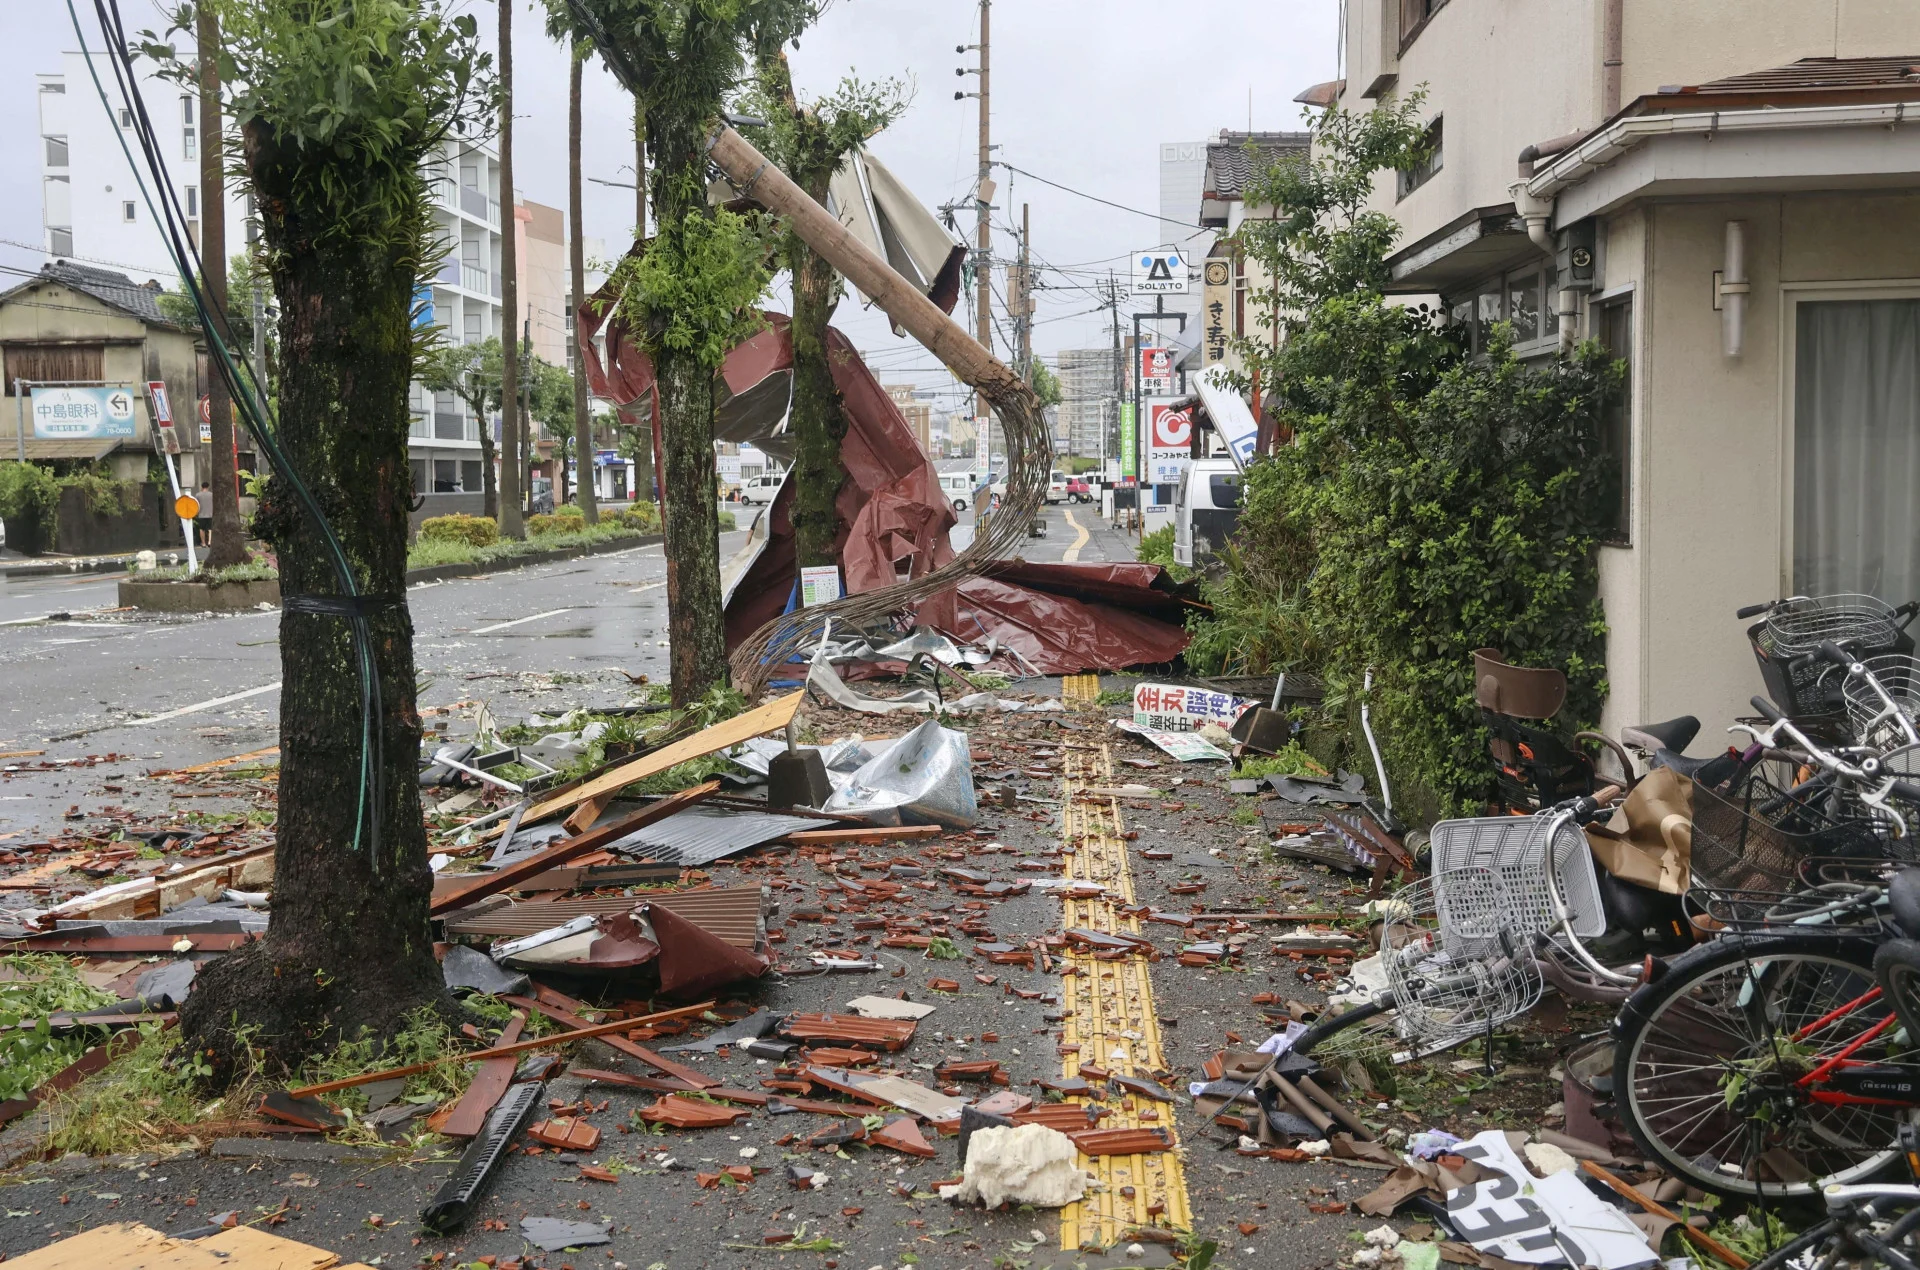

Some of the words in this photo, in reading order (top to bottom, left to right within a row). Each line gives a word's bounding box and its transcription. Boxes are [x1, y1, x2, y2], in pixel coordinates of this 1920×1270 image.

[1138, 282, 1183, 290] SOLATO
[1207, 300, 1227, 360] きく寿司
[1144, 378, 1162, 388] 車検
[37, 403, 99, 419] 中島眼科
